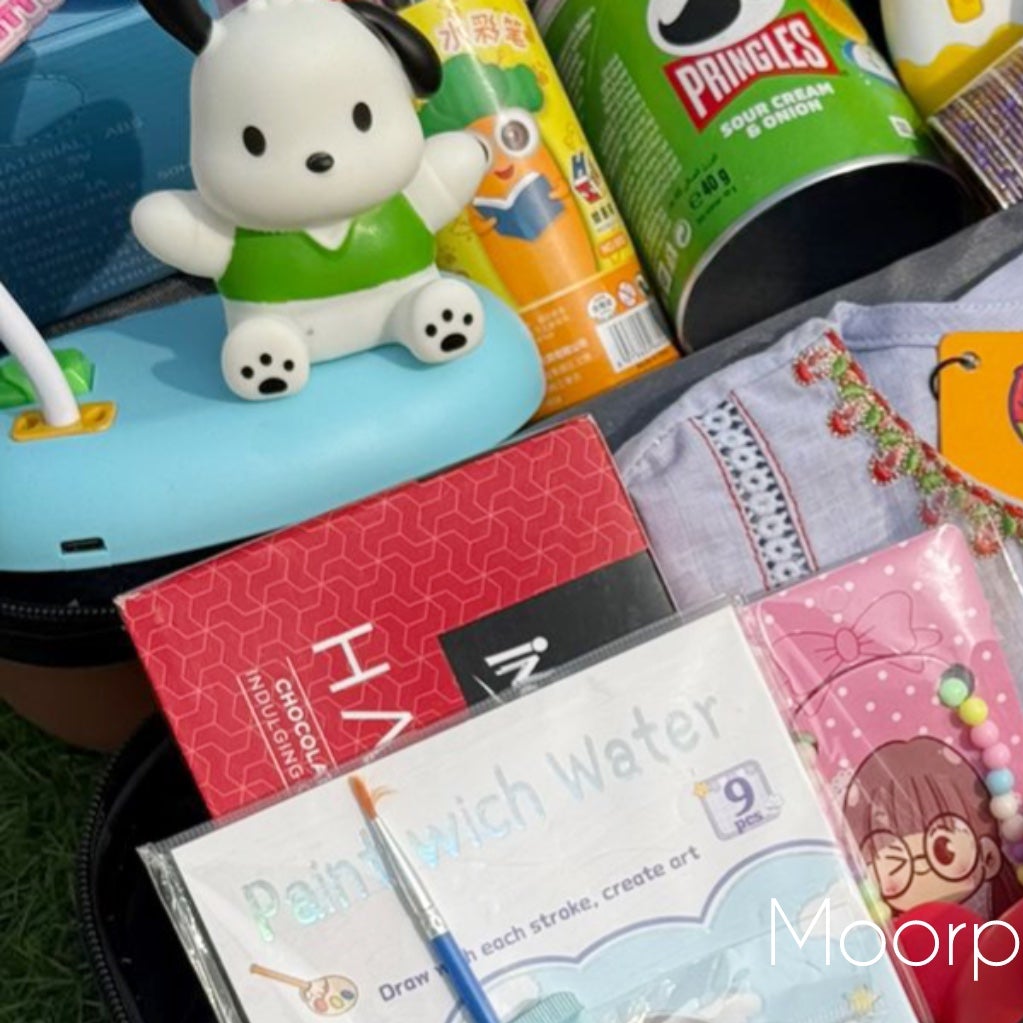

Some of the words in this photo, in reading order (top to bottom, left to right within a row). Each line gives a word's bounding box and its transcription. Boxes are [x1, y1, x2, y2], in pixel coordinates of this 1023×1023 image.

[675, 18, 828, 119] PRINGLES
[719, 100, 769, 139] SOUR
[770, 81, 835, 113] CREAM
[744, 122, 762, 140] &
[762, 97, 823, 130] ONION
[245, 667, 305, 781] INDULGING
[545, 694, 722, 804] Water
[723, 775, 757, 819] 9
[733, 809, 766, 835] pcs
[379, 969, 431, 1003] Draw
[481, 926, 527, 959] each
[529, 896, 600, 936] stroke,
[601, 863, 667, 902] create
[668, 844, 702, 871] art
